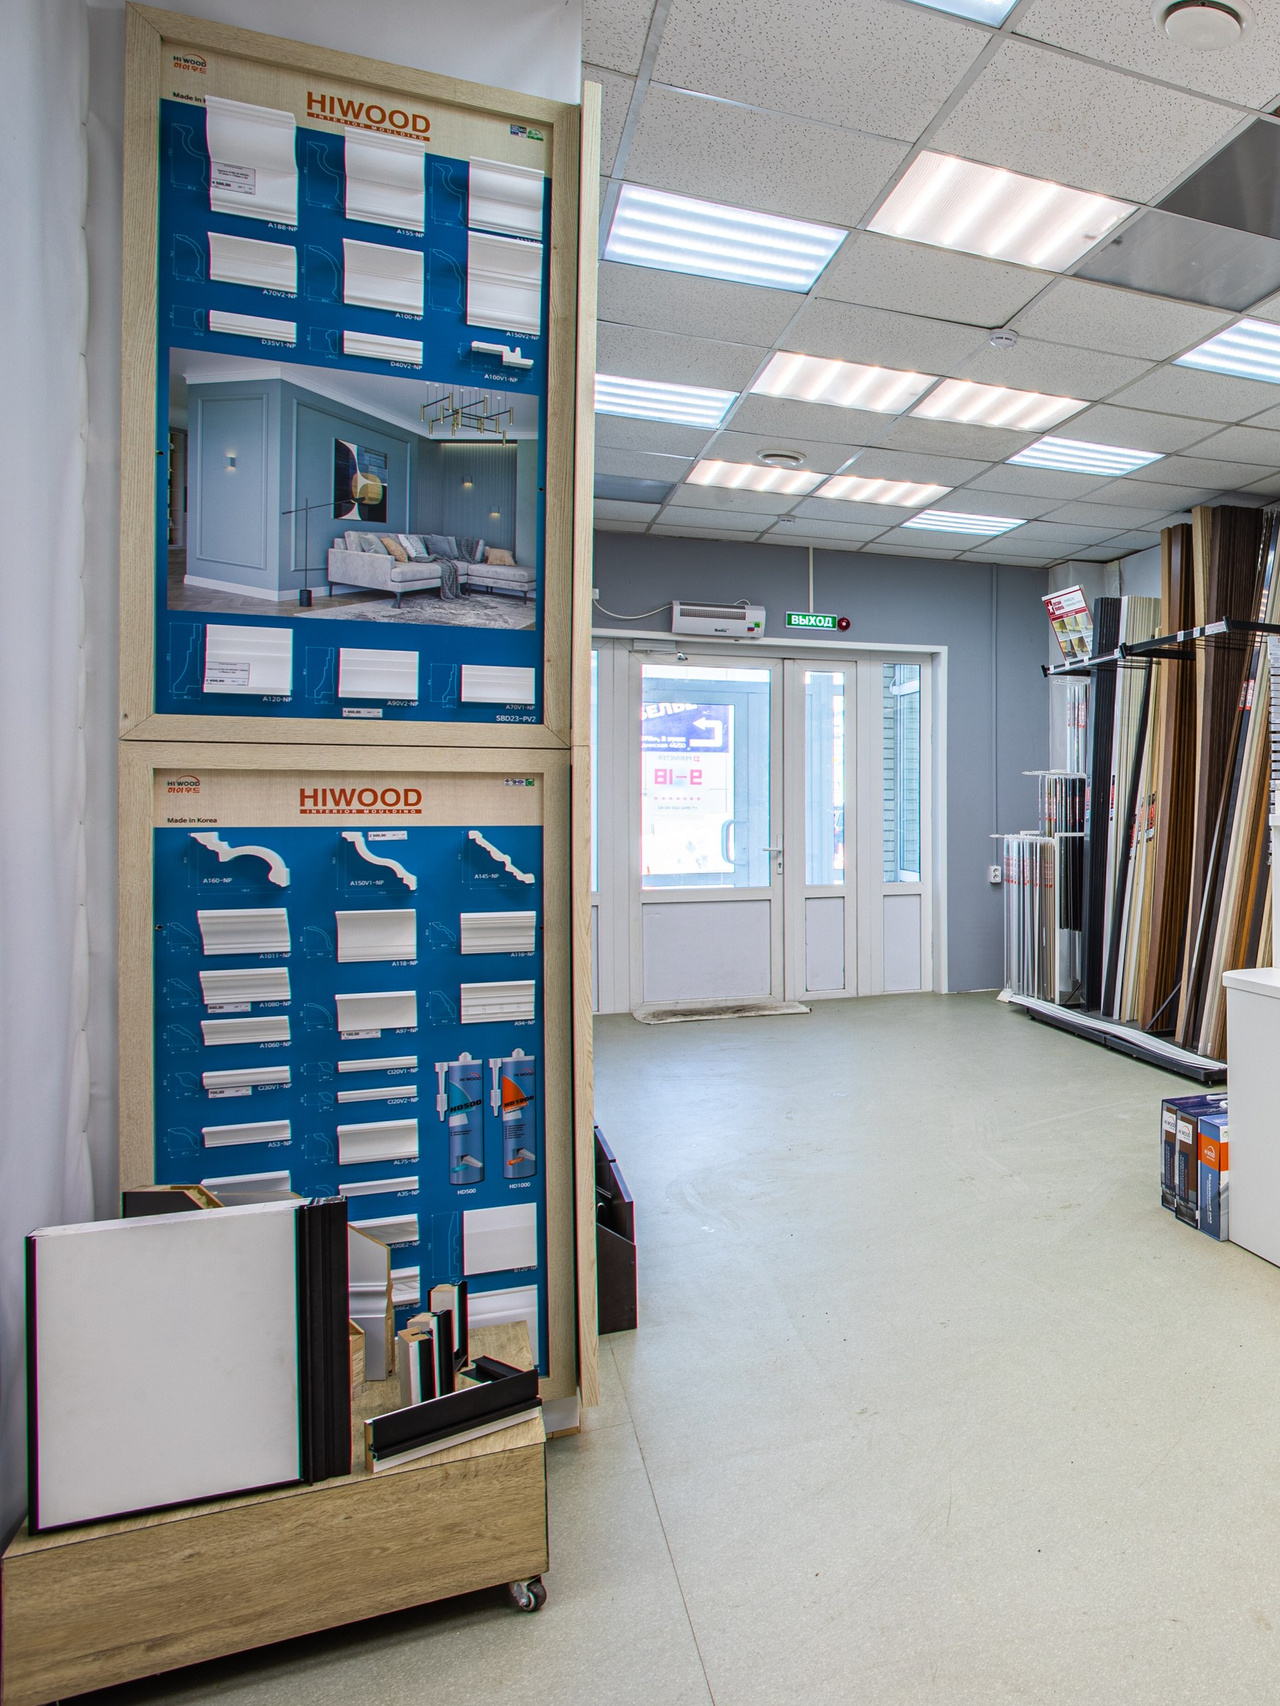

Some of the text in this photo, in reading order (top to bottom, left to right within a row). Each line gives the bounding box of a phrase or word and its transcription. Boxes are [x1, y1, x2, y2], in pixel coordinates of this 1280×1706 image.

[183, 57, 207, 67] WOOD
[173, 92, 191, 101] Made
[307, 91, 431, 133] HIWOOD
[314, 113, 365, 128] INTERIOR
[267, 222, 298, 232] A188-NP
[396, 229, 425, 238] A155-NP
[262, 289, 298, 299] A70V2-NP
[395, 312, 424, 321] A100-NP
[506, 331, 540, 340] A150V2-NP
[261, 338, 297, 349] D35V1-NP
[390, 360, 423, 371] D40V2-NP
[484, 373, 518, 383] A100V1-NP
[790, 615, 833, 628] ВЫХОД
[496, 714, 536, 723] SBD23-PV2
[300, 788, 422, 807] HIWOOD
[259, 1041, 292, 1049] A1060-NP
[450, 1099, 482, 1112] HD500
[504, 1095, 535, 1107] HD1000
[268, 1140, 293, 1148] A53-NP
[509, 1181, 530, 1189] HD1000
[397, 1189, 420, 1197] A35-NP
